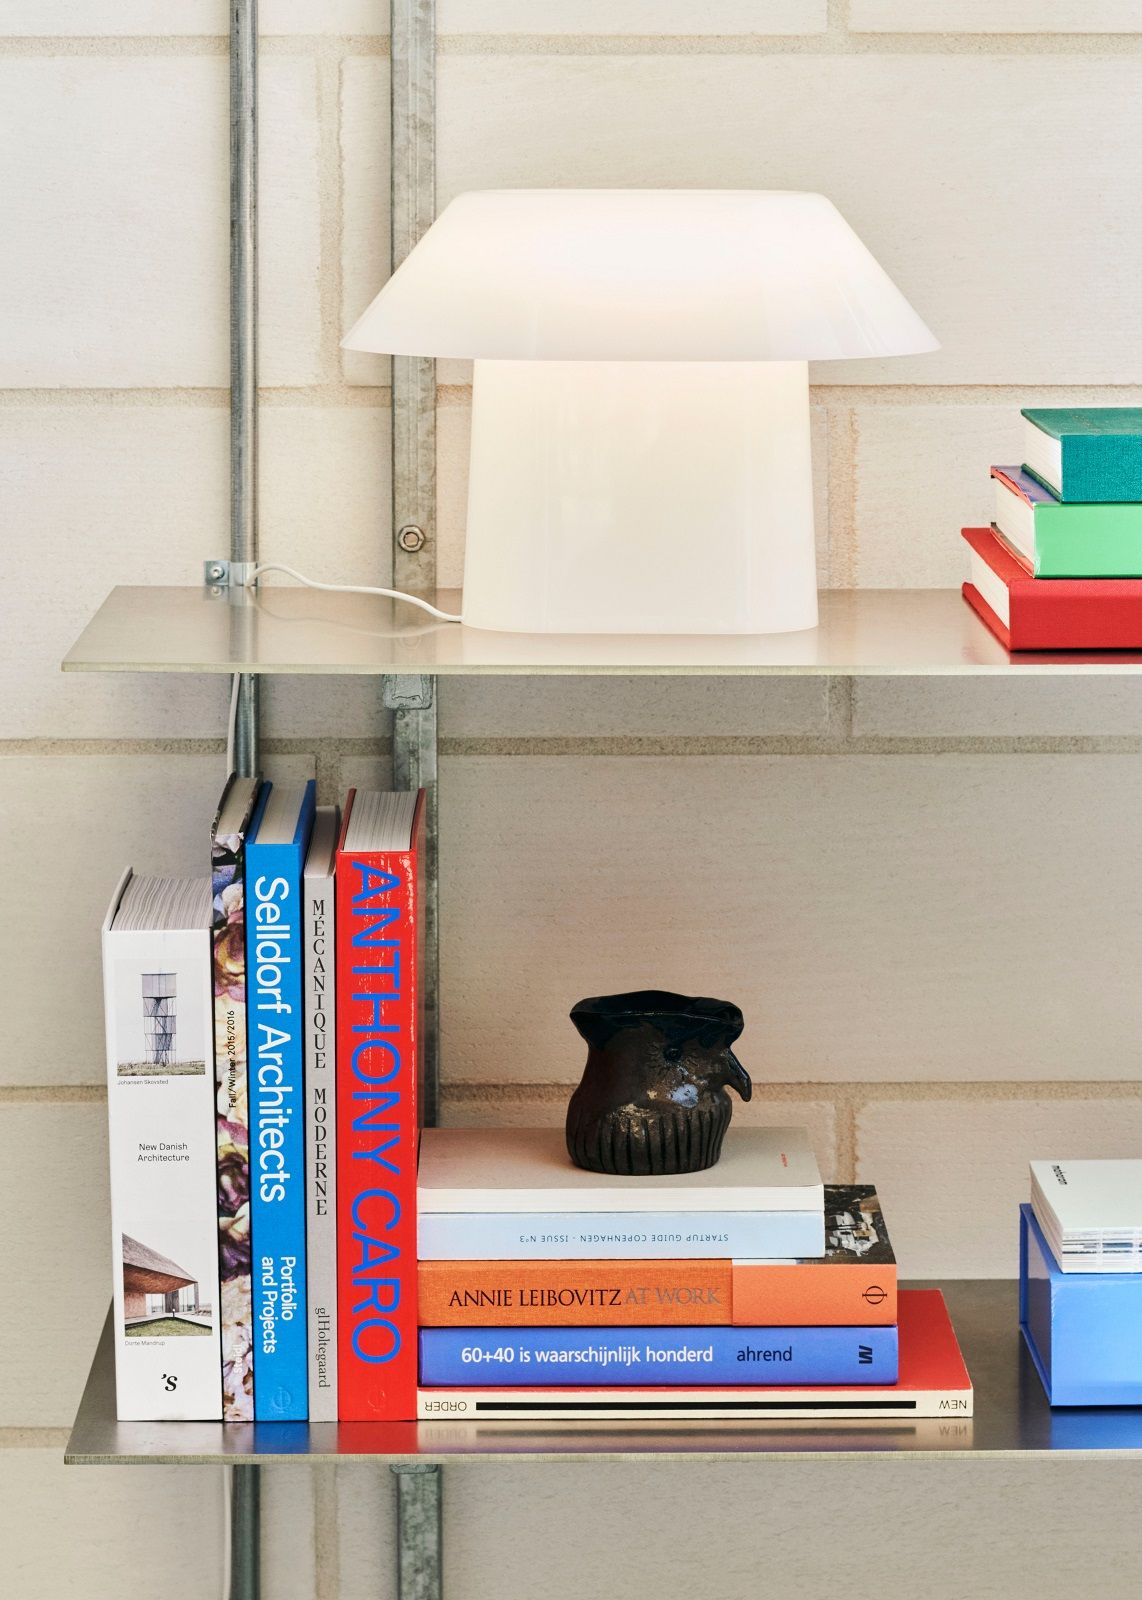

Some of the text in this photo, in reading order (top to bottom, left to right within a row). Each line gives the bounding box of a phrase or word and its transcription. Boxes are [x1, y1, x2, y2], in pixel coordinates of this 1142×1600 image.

[255, 875, 293, 1203] Selldorf Architects
[226, 1010, 237, 1108] Fall/Winter 2015/2016
[312, 899, 328, 1216] MÉCANIQUE MODERNE
[351, 861, 401, 1364] ANTHONY CARO
[139, 1142, 188, 1151] New Danish
[137, 1154, 190, 1162] Architecture
[580, 1234, 647, 1243] COPENHAGEN
[651, 1234, 682, 1242] GUIDE
[686, 1233, 729, 1242] STARTUP
[280, 1256, 298, 1321] Portfolio
[448, 1287, 721, 1307] ANNIE LEIBOVITZ AT WORK
[259, 1256, 279, 1354] and Projects
[461, 1345, 713, 1366] 60+40 is waarschijnlijk honderd
[736, 1346, 793, 1362] ahrend
[424, 1399, 968, 1412] NEW ORDER
